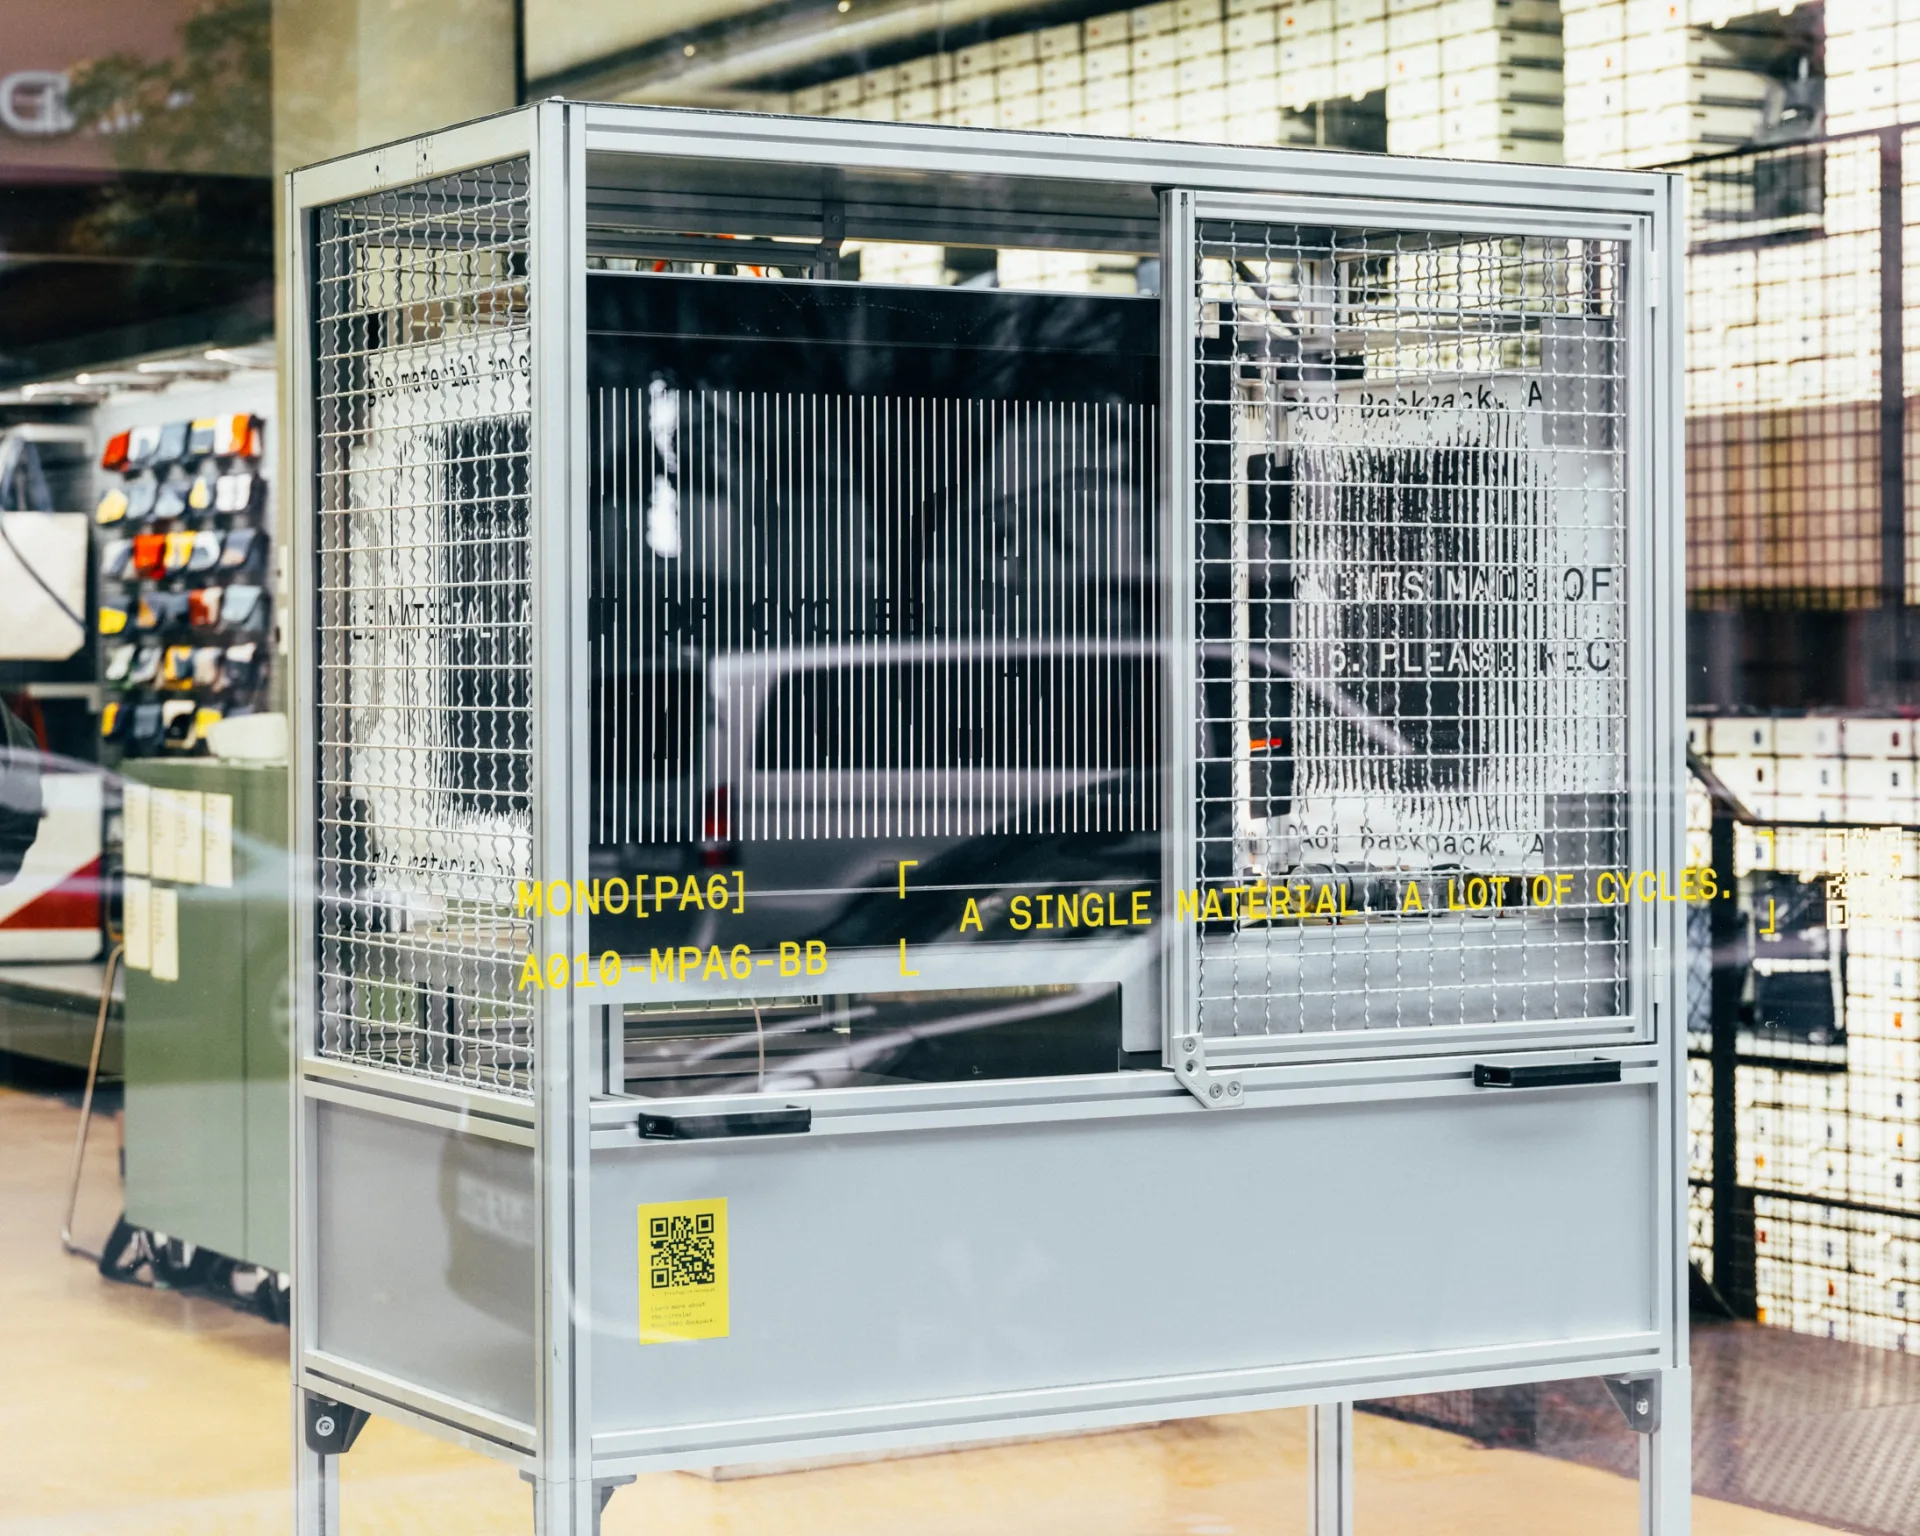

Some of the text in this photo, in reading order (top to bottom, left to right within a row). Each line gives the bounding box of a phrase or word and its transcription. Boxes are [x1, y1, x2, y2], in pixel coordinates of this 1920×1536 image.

[1563, 566, 1613, 602] OF
[1379, 636, 1517, 673] PLEASE
[518, 870, 745, 918] MONO[PA6]
[959, 897, 984, 932] A
[1009, 891, 1152, 930] SINGLE
[1401, 880, 1424, 914] A
[1448, 876, 1509, 911] LOT
[1532, 873, 1575, 907] OF
[1596, 867, 1731, 903] CYCLES.
[518, 939, 829, 991] A010-MPA6-BB
